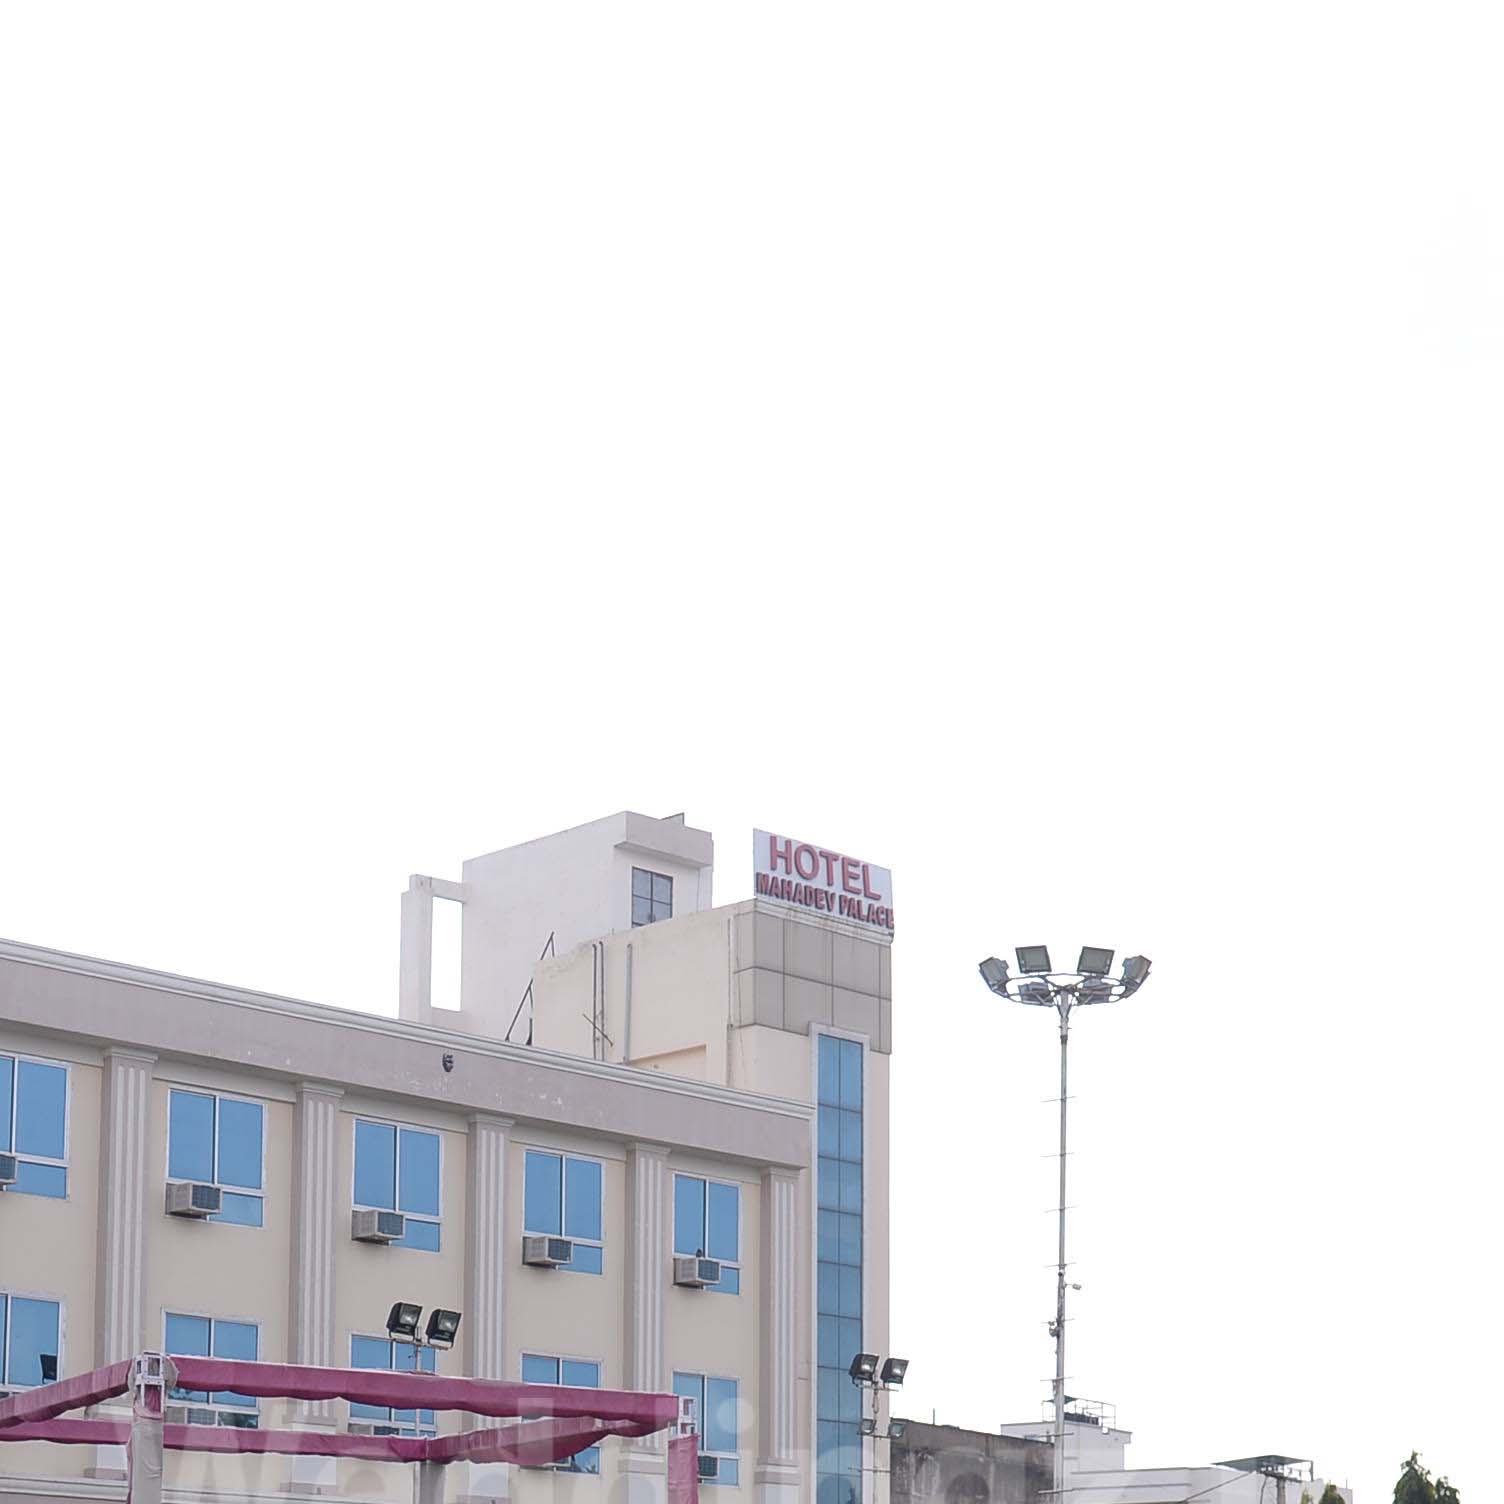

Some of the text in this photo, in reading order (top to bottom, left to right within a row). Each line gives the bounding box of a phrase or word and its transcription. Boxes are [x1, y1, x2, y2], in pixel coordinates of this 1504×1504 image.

[769, 834, 881, 901] HOTEL
[755, 871, 894, 930] MAHADEV PALACE
